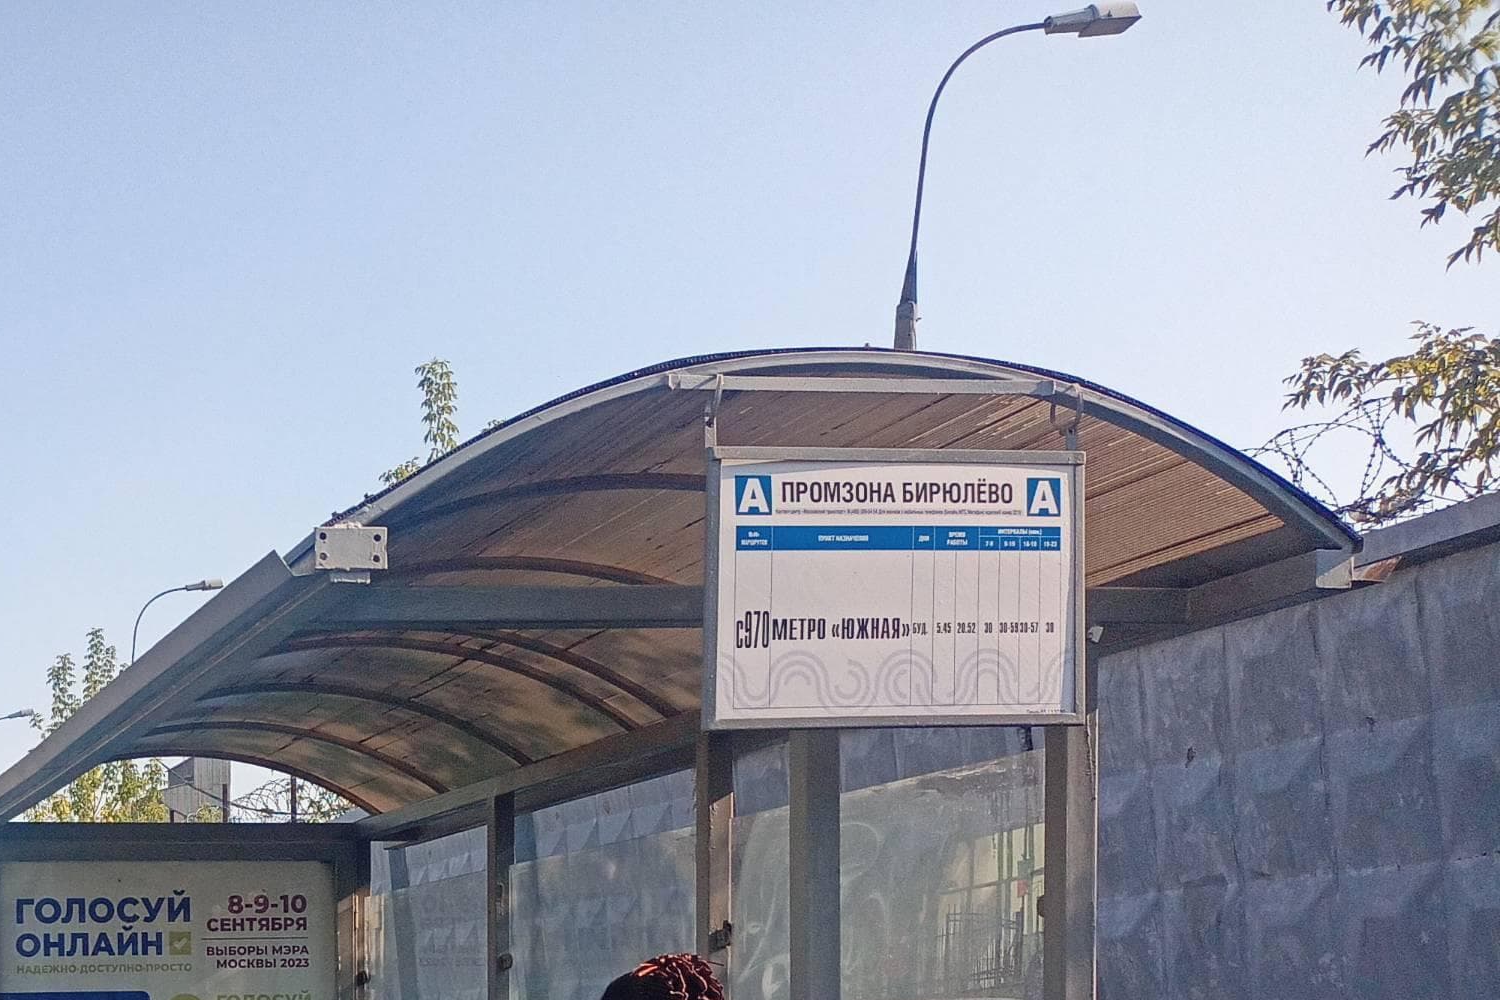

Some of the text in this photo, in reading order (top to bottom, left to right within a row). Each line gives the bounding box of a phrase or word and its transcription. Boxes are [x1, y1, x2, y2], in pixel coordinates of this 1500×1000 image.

[782, 478, 1013, 504] ПРОМЗОНА БИРЮЛЁВО
[736, 611, 770, 648] с970
[772, 617, 910, 640] МЕТРО «ЮЖНАЯ»
[936, 622, 952, 634] 5.45
[957, 622, 976, 634] 20.52
[16, 889, 191, 924] ГОЛОСУЙ
[227, 894, 308, 914] 8-9-10
[206, 917, 308, 932] СЕНТЯБРЯ
[16, 925, 163, 958] ОНЛАЙН
[206, 945, 309, 956] ВЫБОРЫ МЭРА
[216, 958, 310, 969] МОСКВЫ 2023
